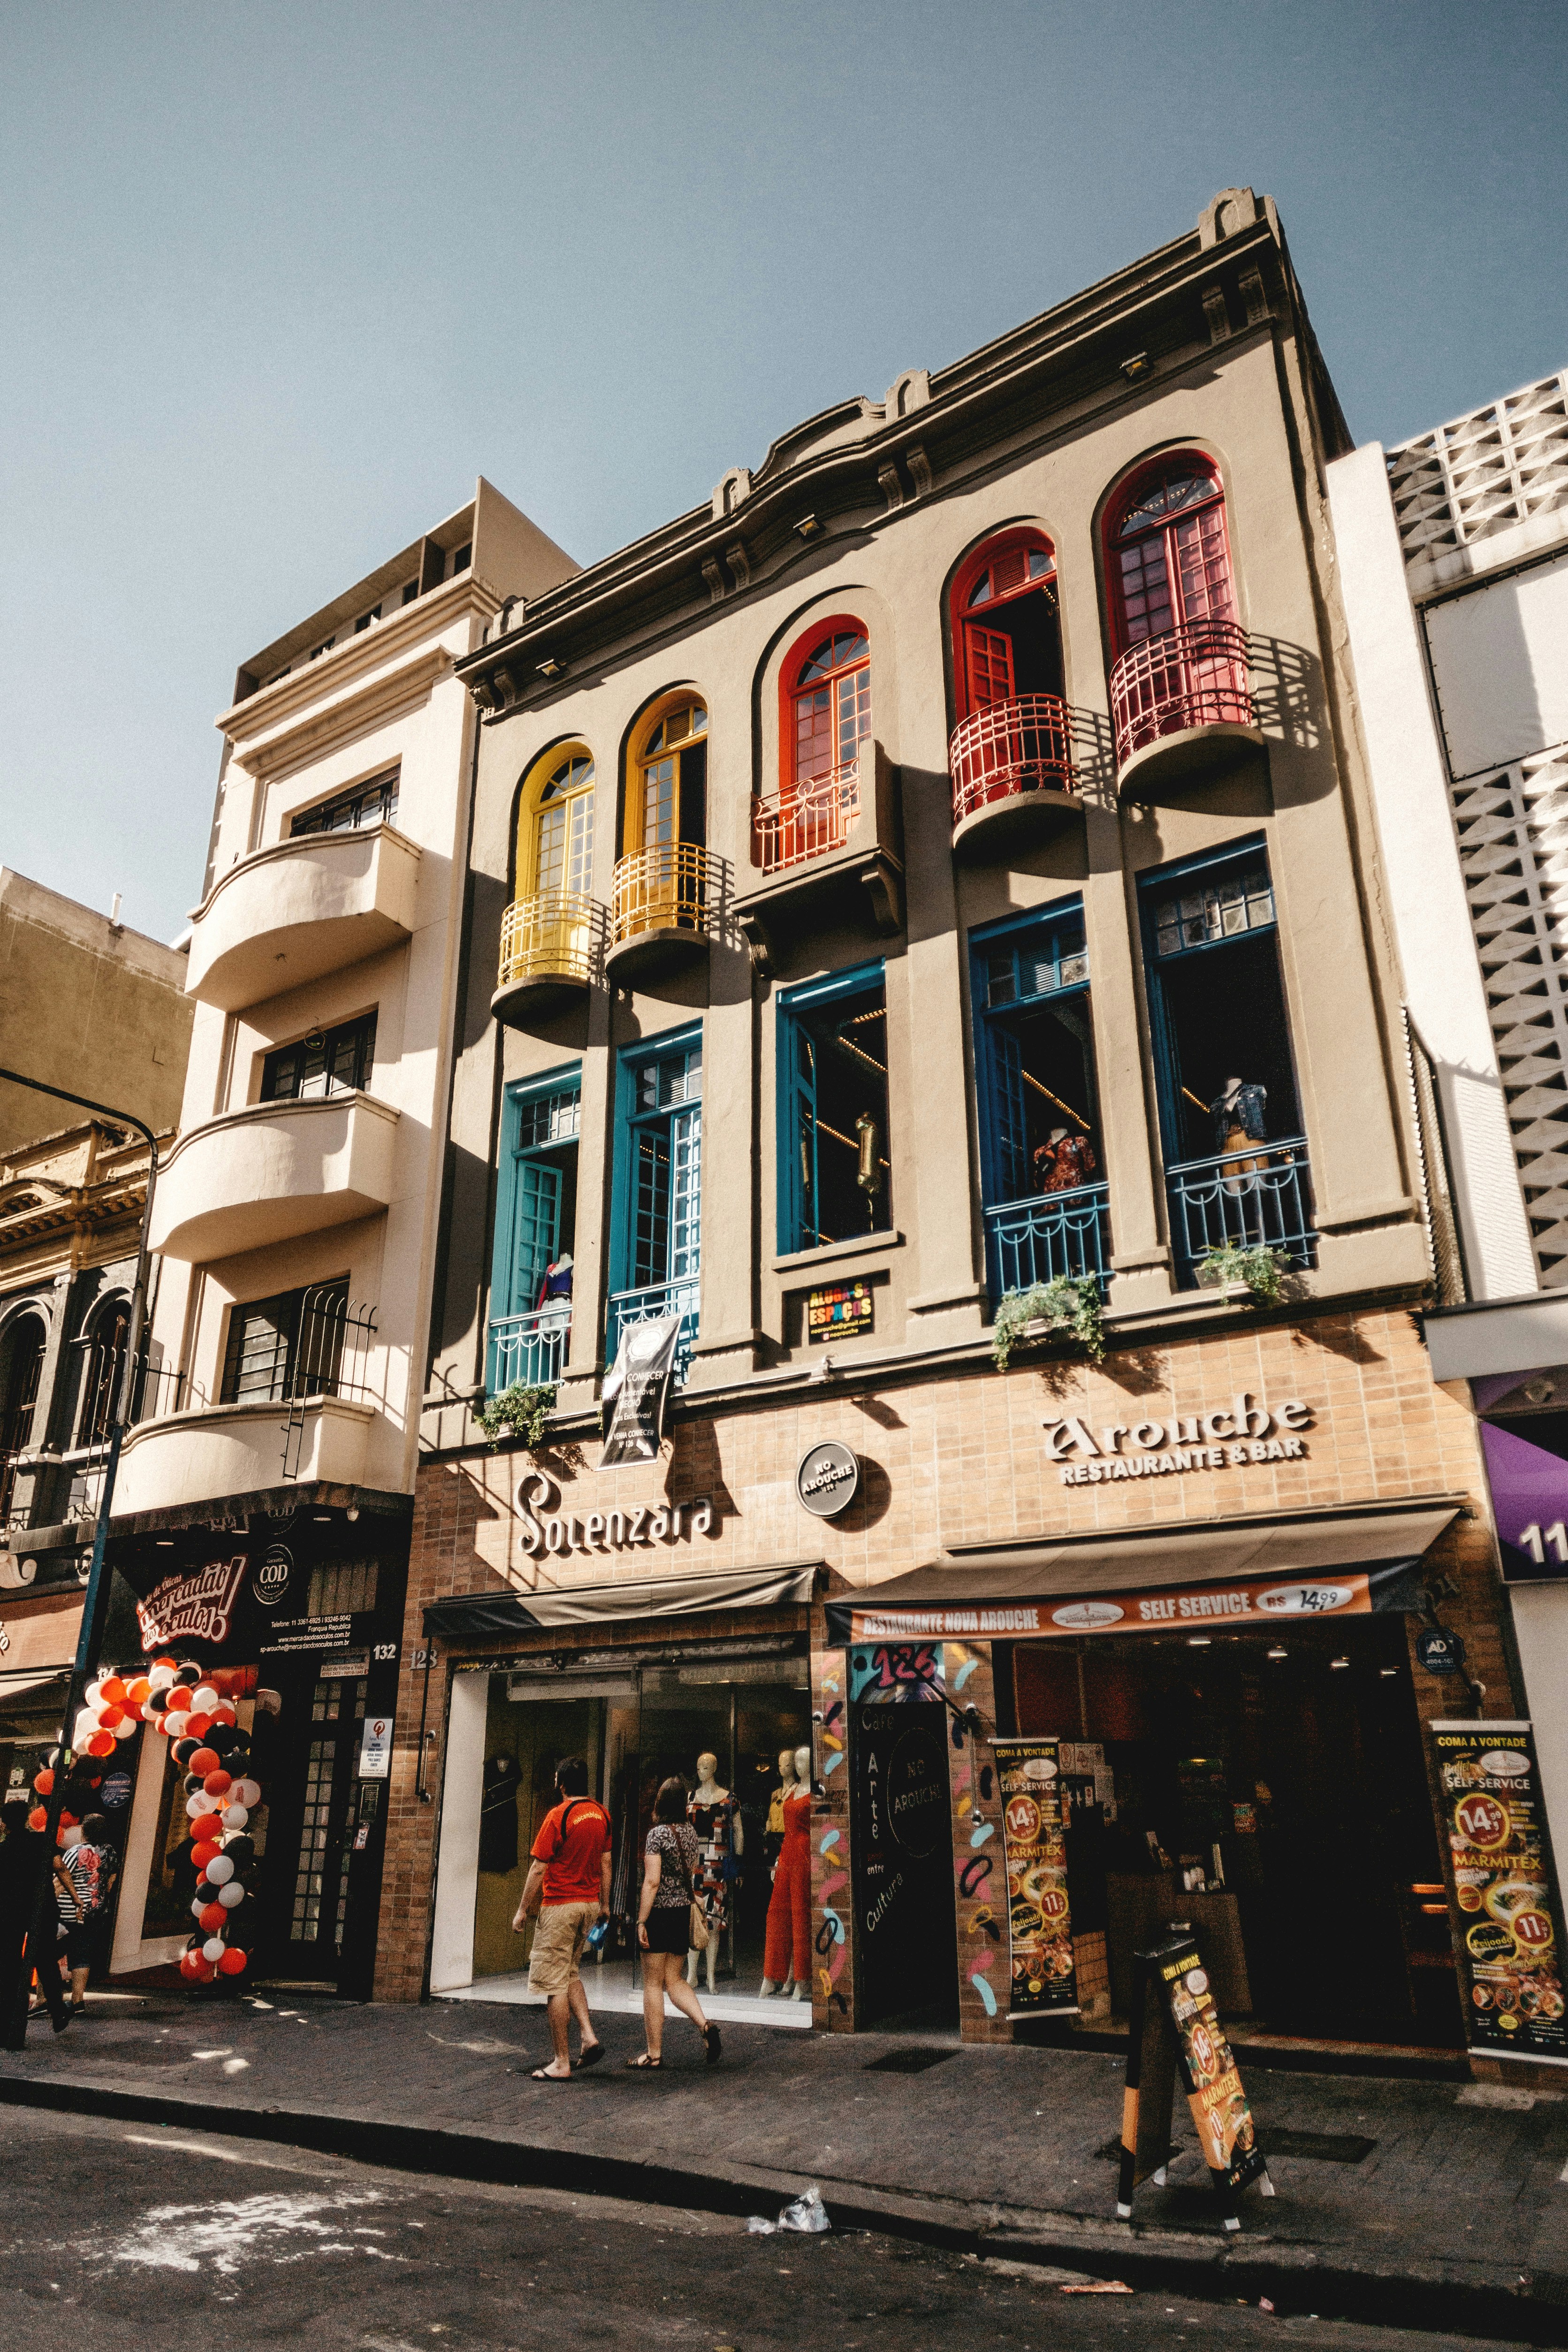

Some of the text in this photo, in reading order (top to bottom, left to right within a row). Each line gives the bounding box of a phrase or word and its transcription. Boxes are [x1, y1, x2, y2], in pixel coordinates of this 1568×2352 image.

[810, 1283, 870, 1308] ALUGA-SE
[810, 1298, 871, 1325] ESPAÇOS
[811, 1318, 871, 1334] noarouche@gmail.com
[830, 1328, 859, 1338] noarouche
[627, 1370, 663, 1382] CONHECER
[624, 1411, 652, 1421] Exclusivas!
[628, 1429, 654, 1438] CONHECER
[1043, 1393, 1310, 1460] Arouche
[814, 1461, 831, 1475] NO
[1060, 1437, 1303, 1485] RESTAURANTE & BAR
[802, 1464, 853, 1493] AROUCHE
[513, 1472, 711, 1553] Solenzara
[260, 1564, 288, 1583] COD
[1139, 1597, 1176, 1621] SELF
[1179, 1592, 1251, 1617] SERVICE
[1301, 1590, 1338, 1611] 14,99
[297, 1617, 321, 1626] 3361-6925
[328, 1623, 351, 1631] Republica
[863, 1613, 943, 1636] RESTAURANTE
[945, 1611, 978, 1632] NOVA
[980, 1609, 1040, 1631] AROUCHE
[373, 1644, 396, 1660] 132
[873, 1644, 936, 1687] 126
[1438, 1736, 1527, 1747] COMA A VONTADE
[997, 1749, 1015, 1758] COMA
[1023, 1748, 1055, 1757] VONTADE
[1001, 1781, 1057, 1792] SELF SERVICE
[1446, 1777, 1530, 1790] SELF SERVICE
[868, 1752, 879, 1840] Arte
[868, 1864, 884, 1875] entre
[1455, 1853, 1542, 1870] MARMITEX
[867, 1873, 904, 1932] Cultura
[1201, 2071, 1240, 2111] MARMITEX
